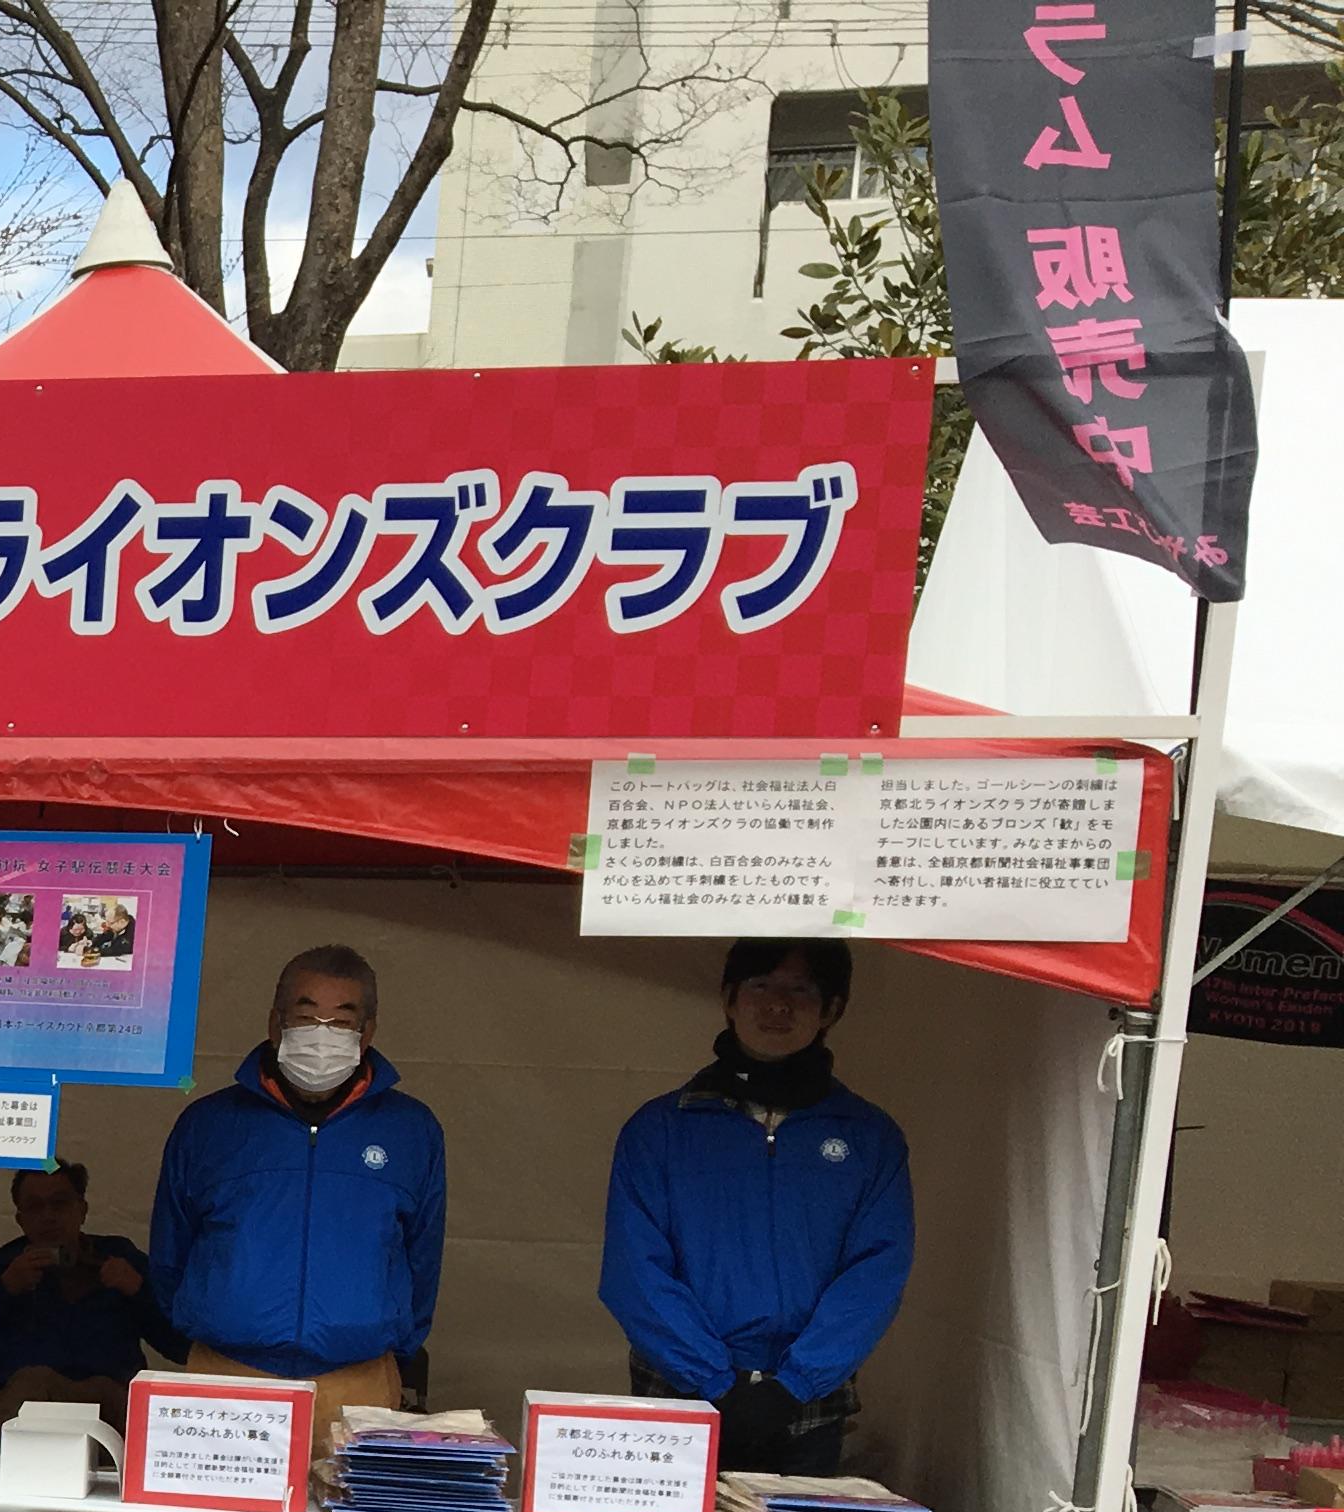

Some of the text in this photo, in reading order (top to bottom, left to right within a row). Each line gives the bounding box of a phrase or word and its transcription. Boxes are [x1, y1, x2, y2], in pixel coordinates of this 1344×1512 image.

[607, 837, 665, 849] しました。
[877, 836, 1112, 849] チーフにしています。みなさまからの
[872, 895, 949, 907] ただきます。
[158, 1406, 289, 1424] 京都北ライオンズクラブ
[173, 1425, 271, 1441] 心のふれあい募金
[556, 1427, 694, 1446] 京都北ライオンズクラブ
[572, 1447, 674, 1463] 心のふれあい募金
